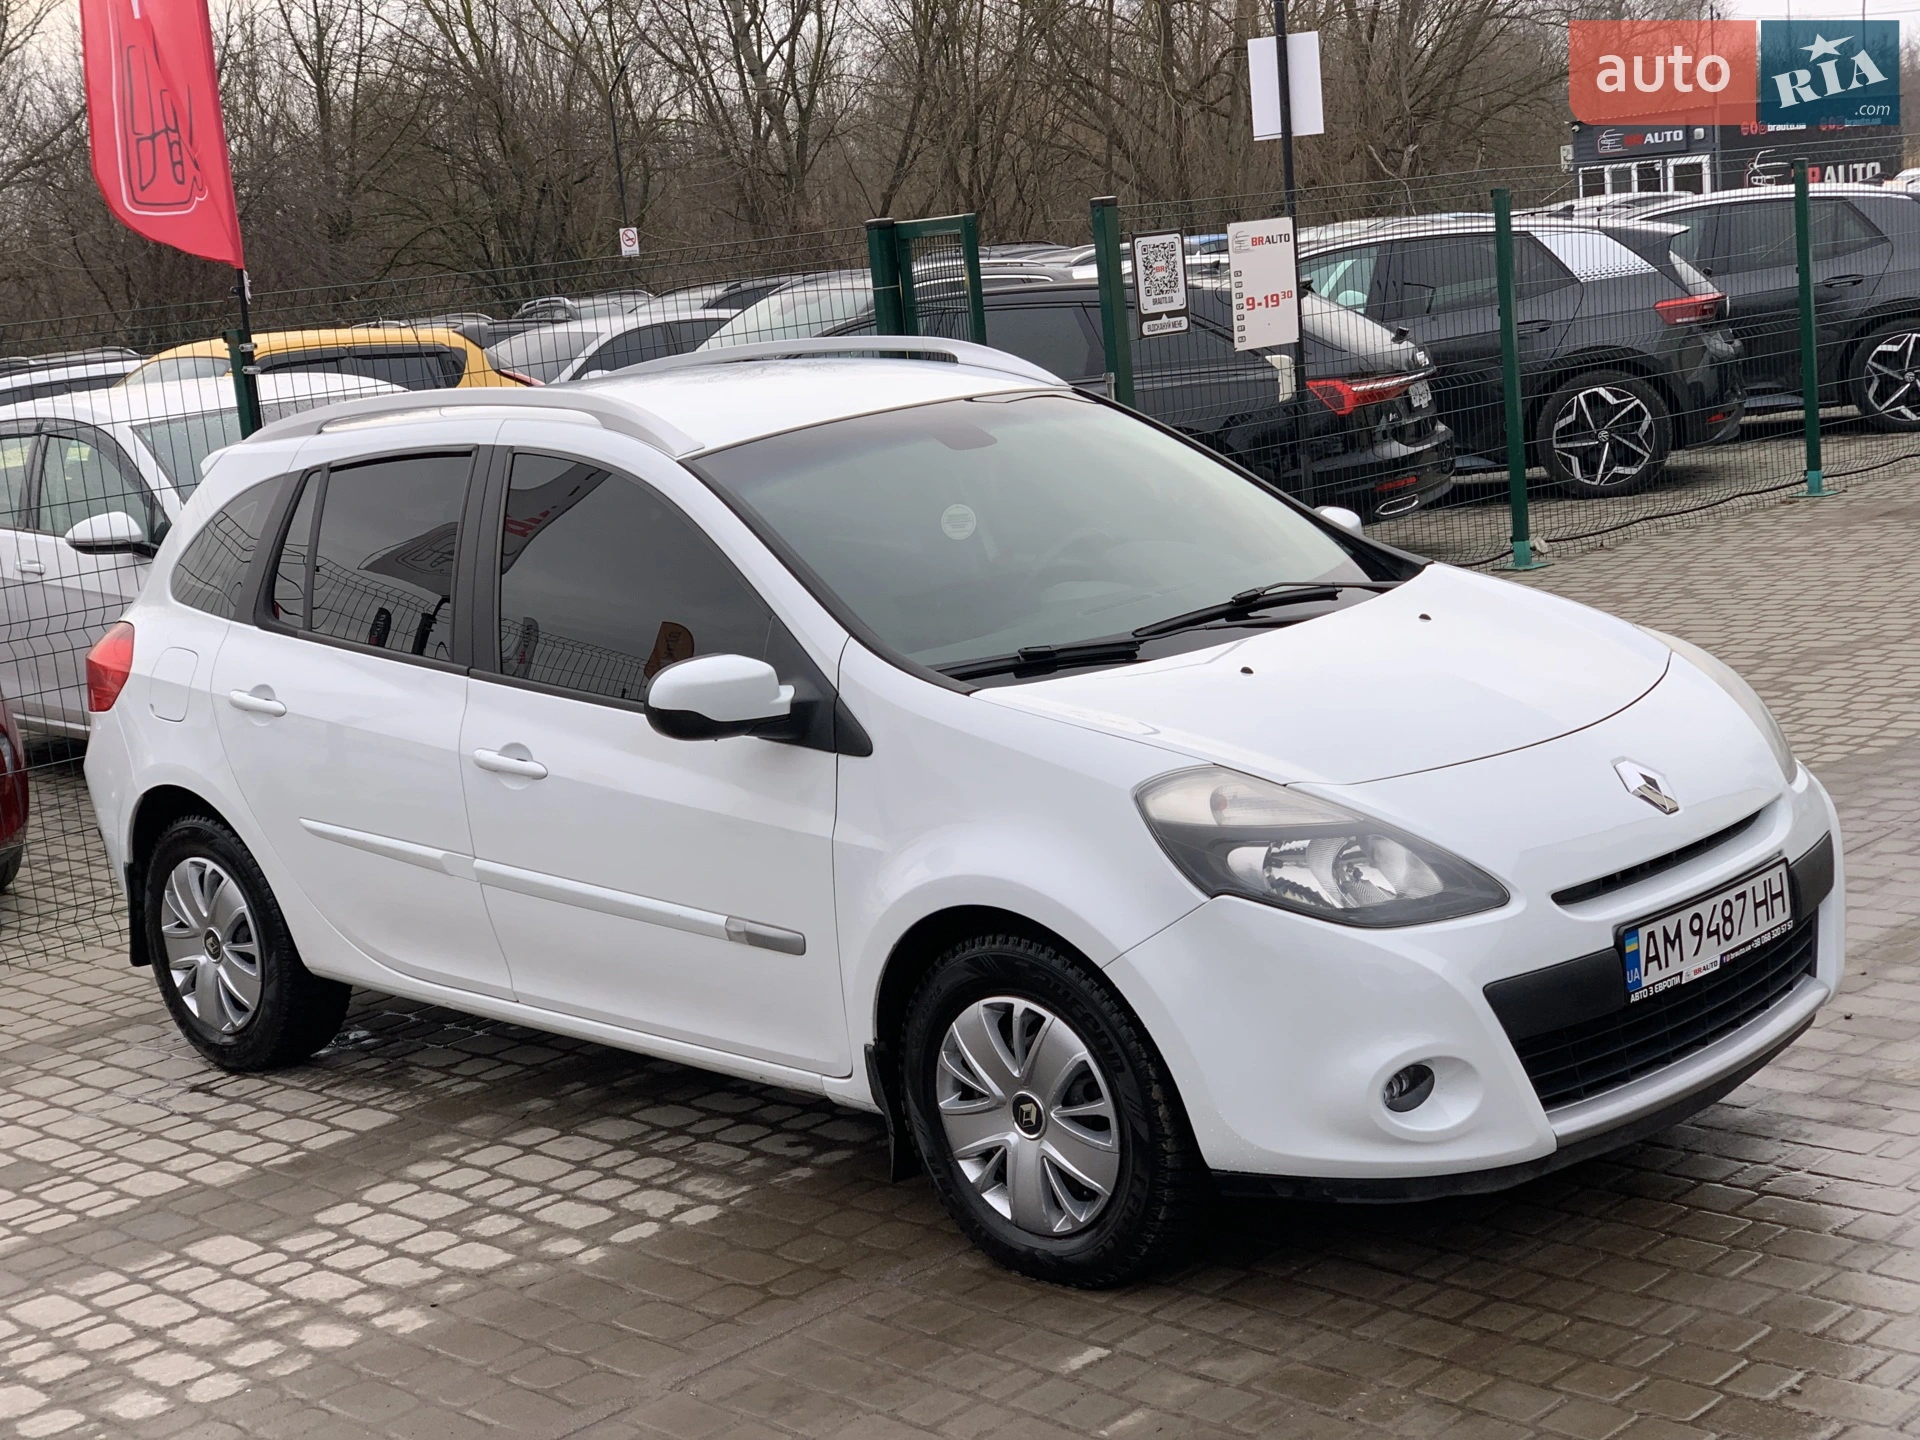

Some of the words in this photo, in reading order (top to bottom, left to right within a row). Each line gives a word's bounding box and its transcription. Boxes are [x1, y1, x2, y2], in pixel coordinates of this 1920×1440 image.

[1791, 162, 1881, 183] RAUTO
[1251, 233, 1290, 246] BRAUTO
[1155, 265, 1166, 273] BR
[1688, 889, 1747, 957] 9487
[1627, 968, 1640, 983] UA
[1693, 960, 1718, 976] BRAUTO
[1630, 989, 1648, 1003] АВТО
